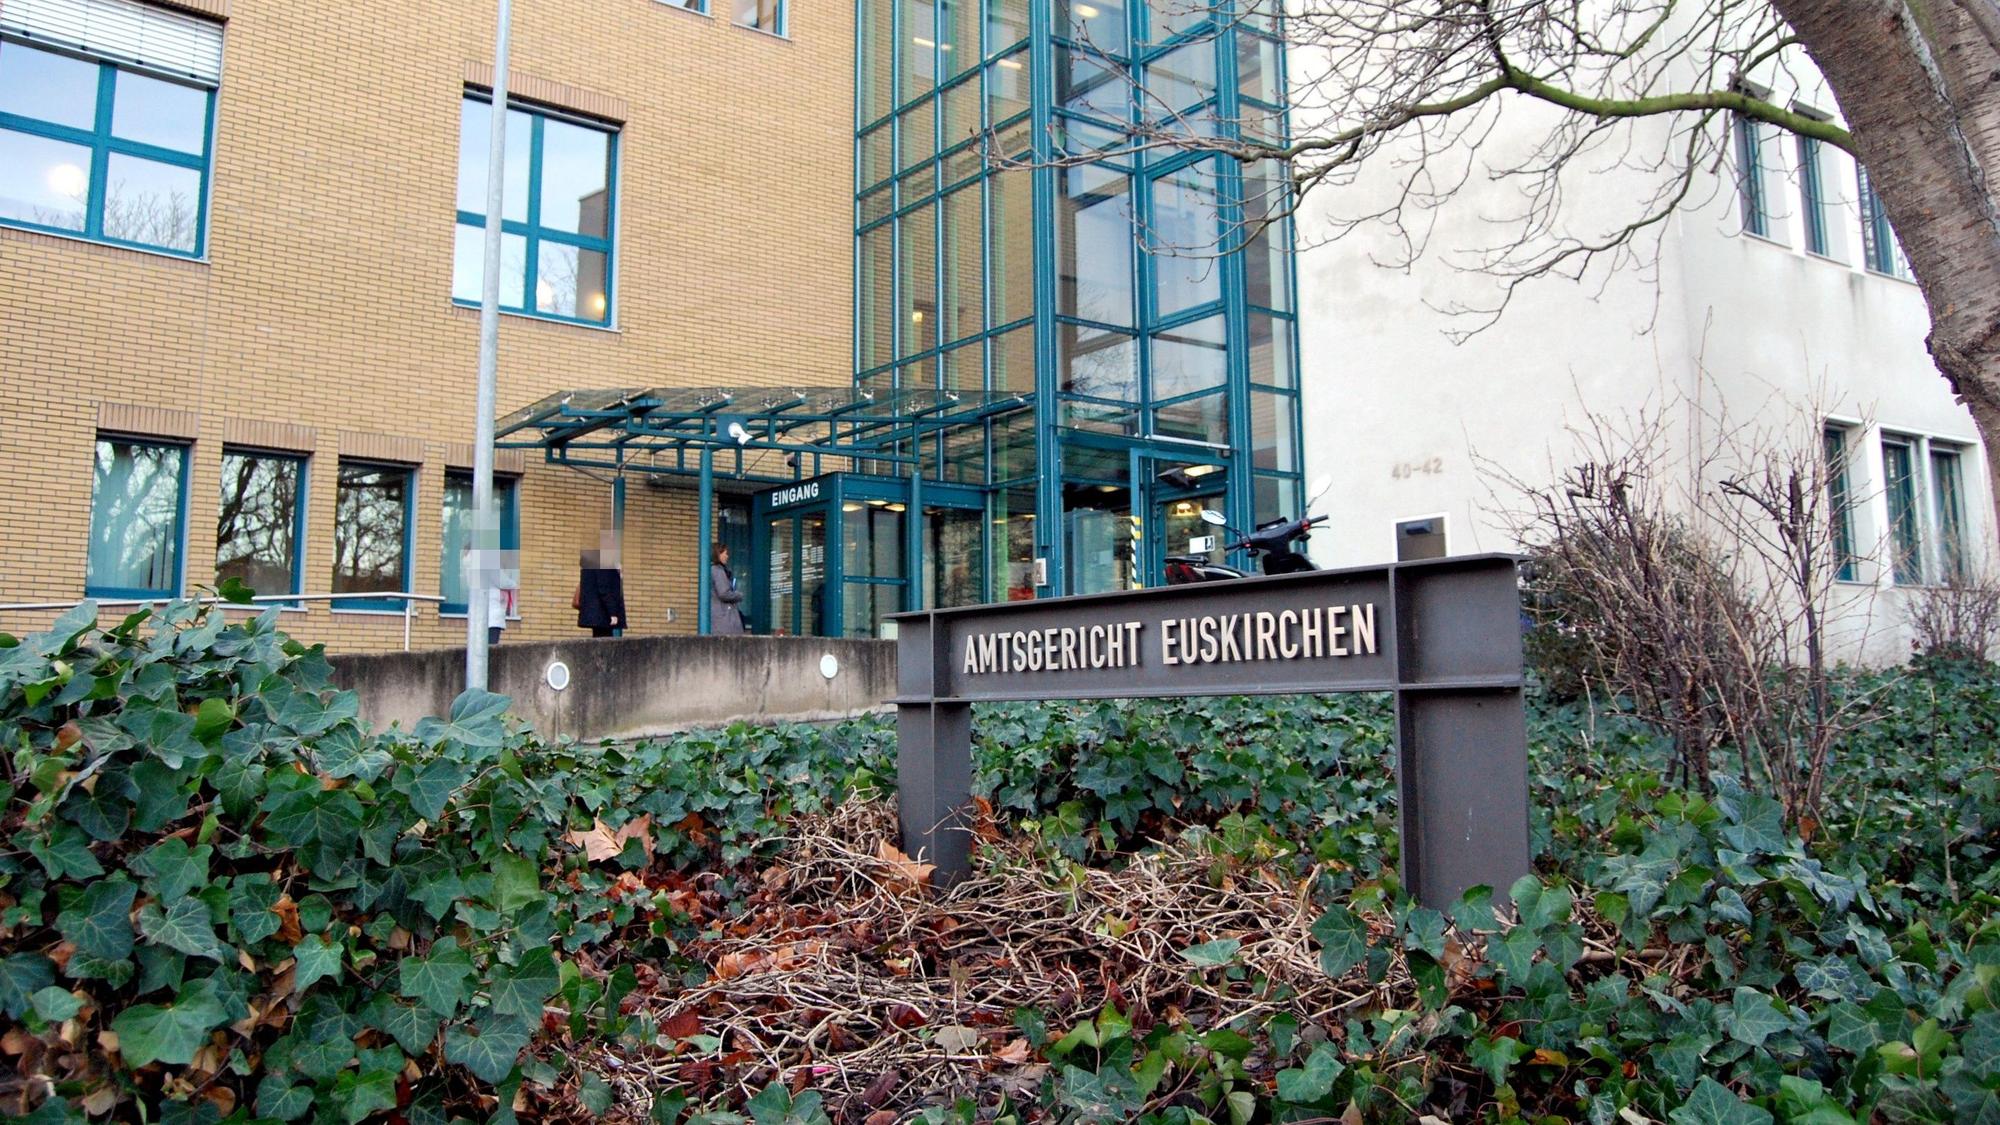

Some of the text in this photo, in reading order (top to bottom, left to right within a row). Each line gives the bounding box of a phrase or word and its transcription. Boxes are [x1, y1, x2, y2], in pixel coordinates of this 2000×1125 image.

[1391, 457, 1443, 480] 40-42
[771, 482, 819, 507] EINGANG
[963, 603, 1376, 674] AMTSGERICHT EUSKIRCHEN
